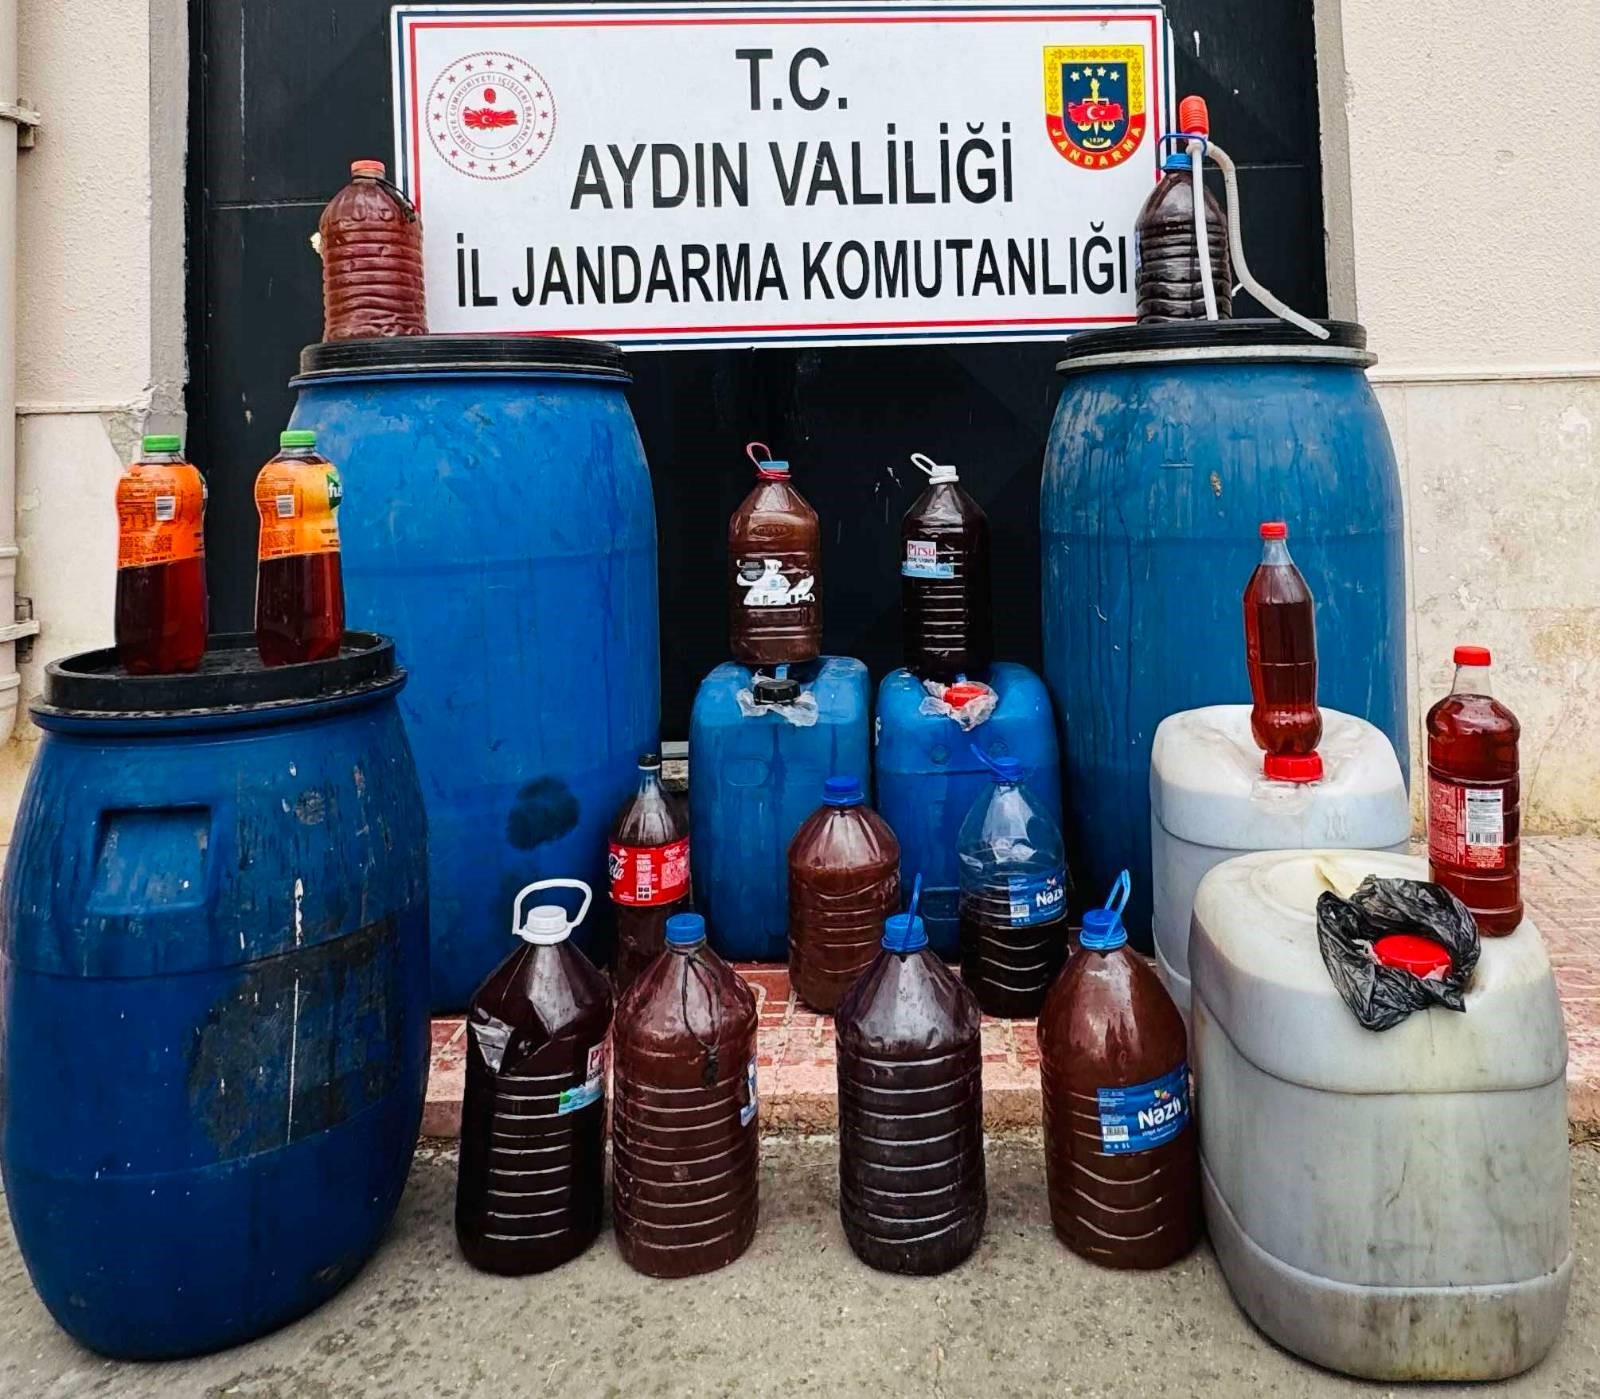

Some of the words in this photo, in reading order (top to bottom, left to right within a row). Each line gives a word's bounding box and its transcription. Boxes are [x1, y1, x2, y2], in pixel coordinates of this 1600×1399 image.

[736, 48, 847, 110] T.C.
[571, 143, 748, 209] AYDIN
[769, 122, 1012, 206] VALİLİĞİ
[1052, 127, 1142, 166] JANDARMA
[457, 233, 497, 307] İL
[513, 243, 788, 306] JANDARMA
[803, 222, 1127, 299] KOMUTANLIĞI
